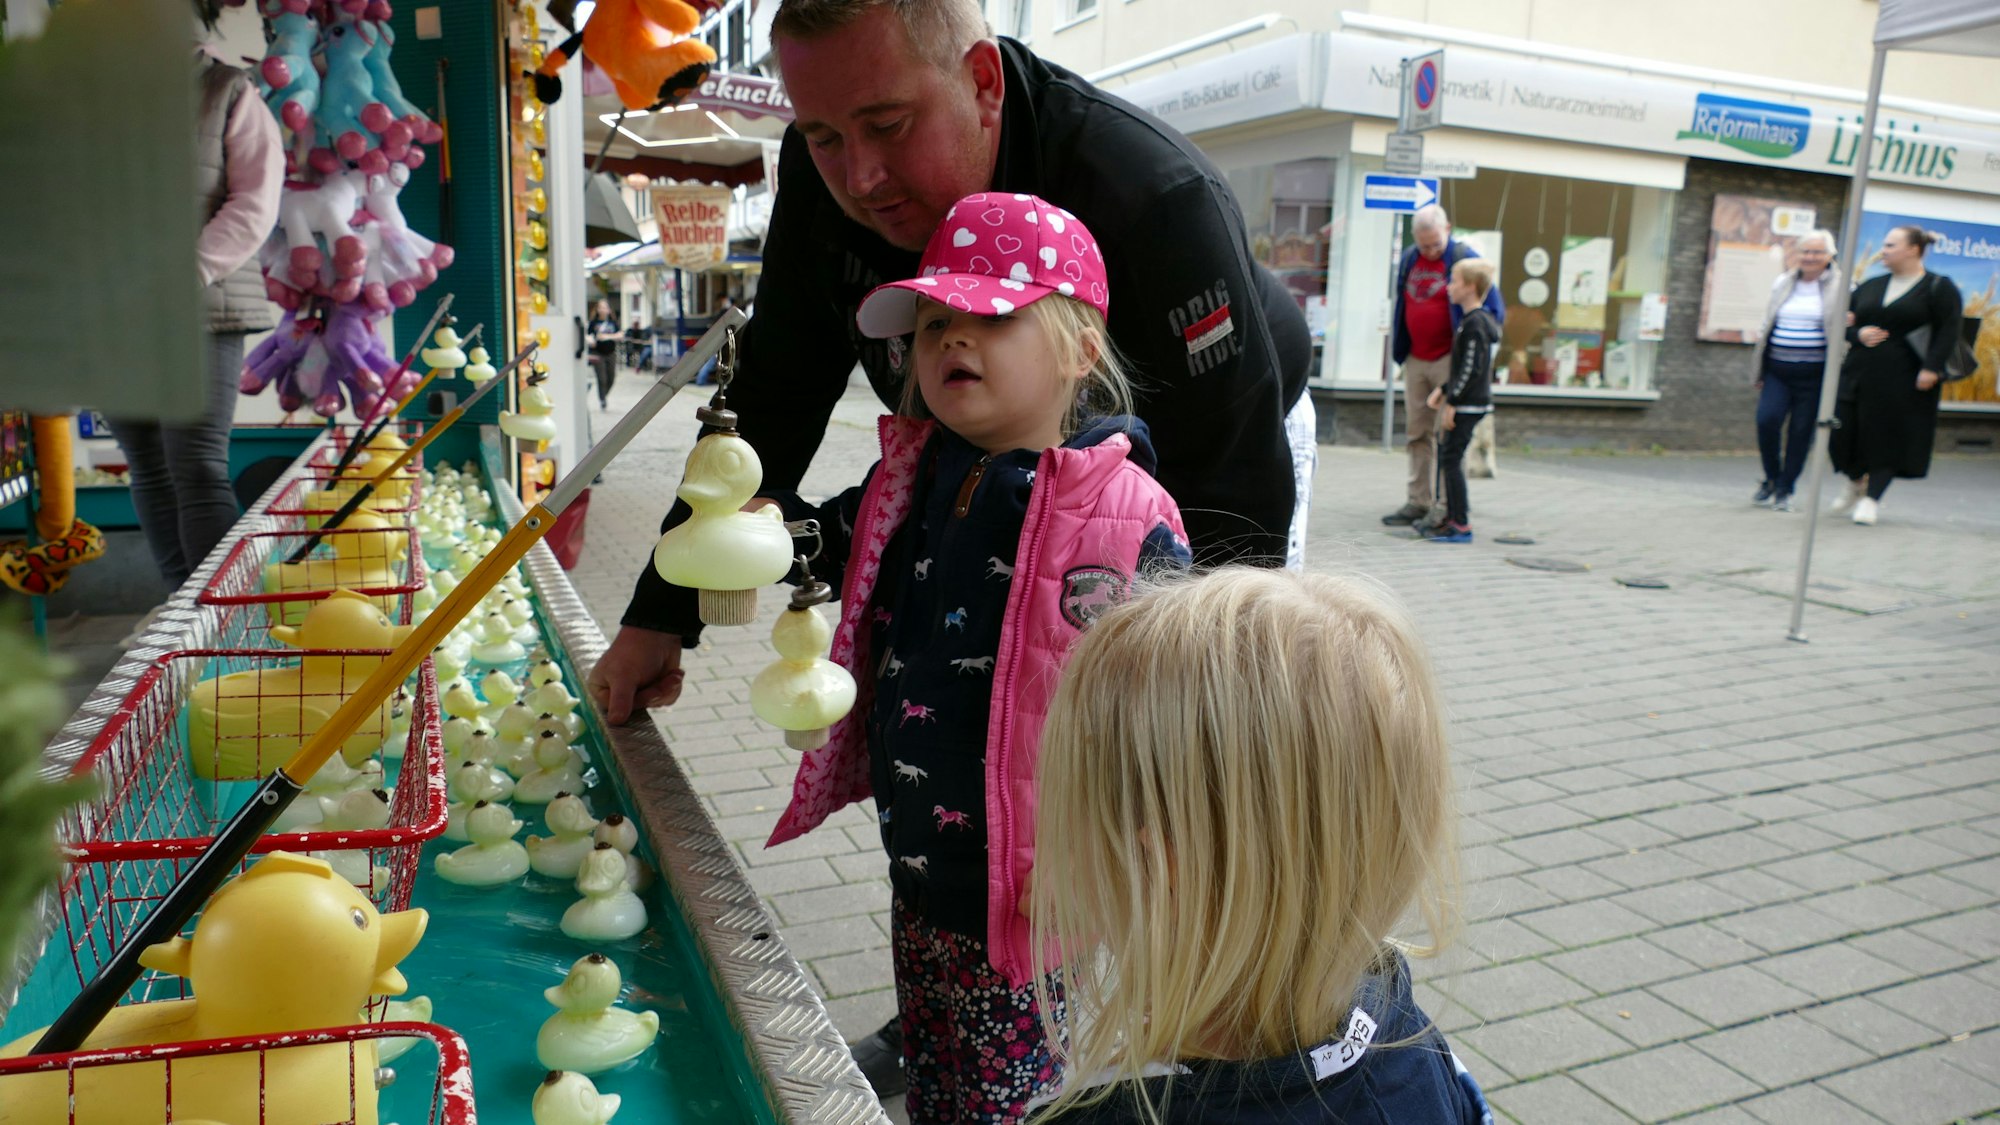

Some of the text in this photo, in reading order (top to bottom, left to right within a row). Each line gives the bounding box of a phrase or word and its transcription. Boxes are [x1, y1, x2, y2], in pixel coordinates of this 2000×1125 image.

[1252, 65, 1282, 92] Café
[1511, 86, 1649, 123] Naturarzneimittel
[1694, 105, 1800, 146] Reformhaus
[662, 201, 724, 223] Reibe-
[1934, 233, 1962, 256] Das
[1070, 572, 1092, 582] TEAM
[1321, 1050, 1333, 1062] 4Y
